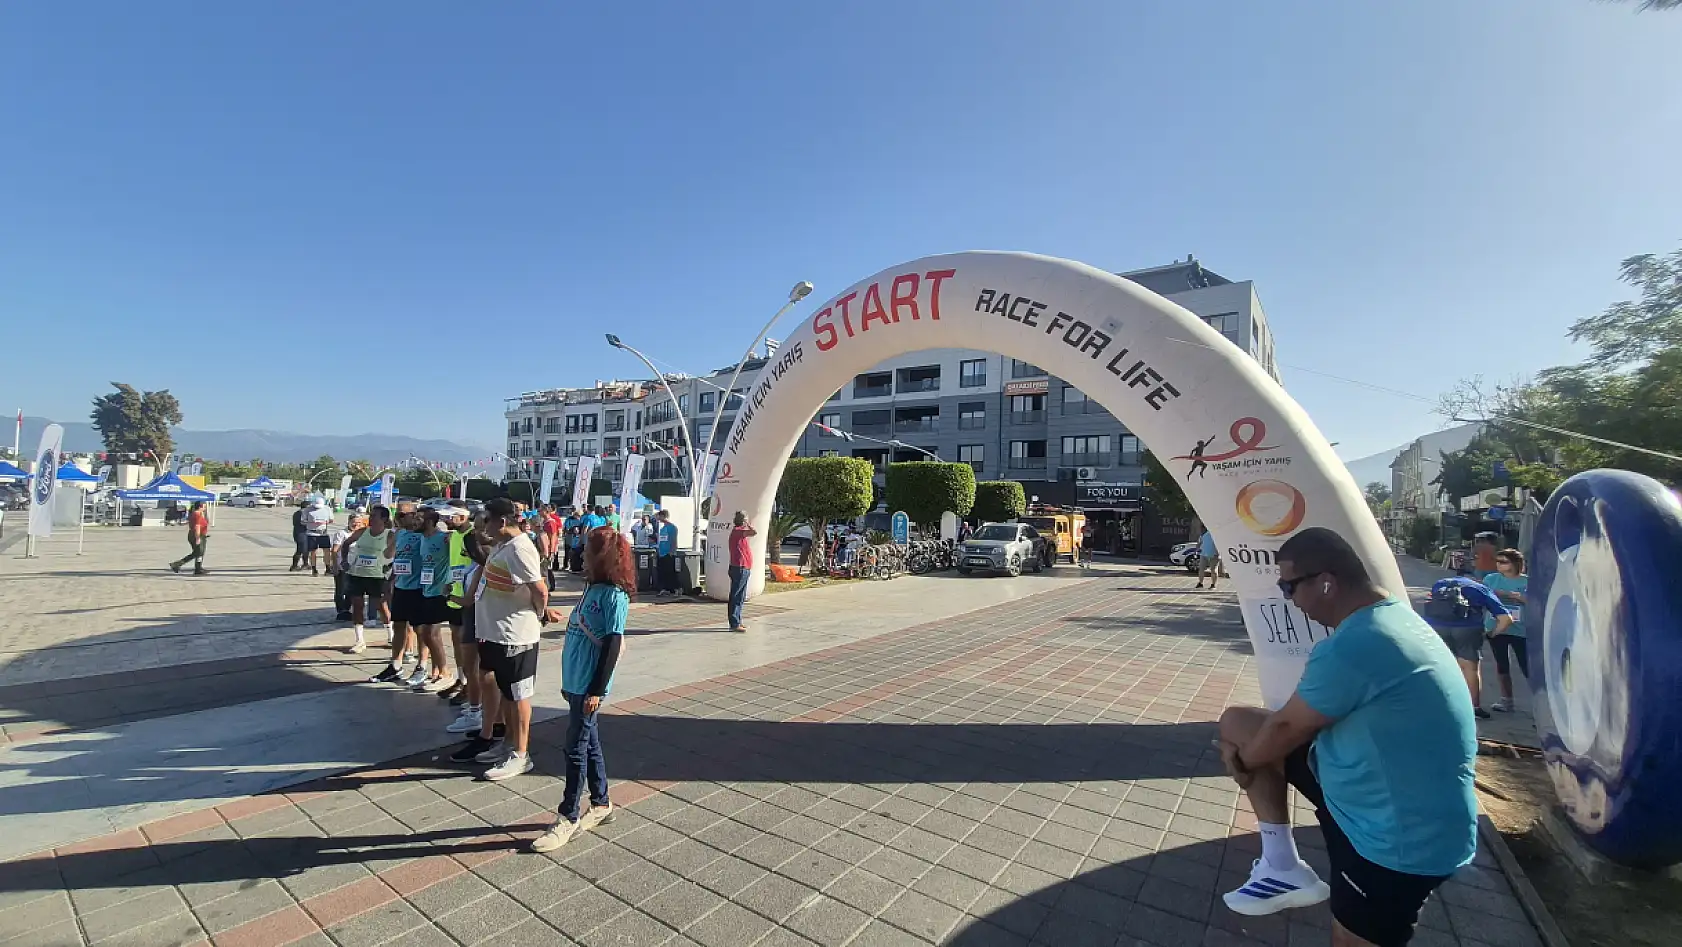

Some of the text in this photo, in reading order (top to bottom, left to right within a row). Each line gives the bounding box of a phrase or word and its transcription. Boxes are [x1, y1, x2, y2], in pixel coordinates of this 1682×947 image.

[812, 268, 957, 352] START
[974, 288, 1182, 411] RACE FOR LIFE
[728, 403, 755, 455] YAŞAM
[771, 340, 804, 381] YARIŞ
[38, 460, 52, 495] Ford
[1211, 460, 1241, 472] YAŞAM
[1264, 456, 1292, 466] YARIŞ
[1087, 488, 1128, 497] FOR YOU
[1260, 603, 1299, 643] SEA
